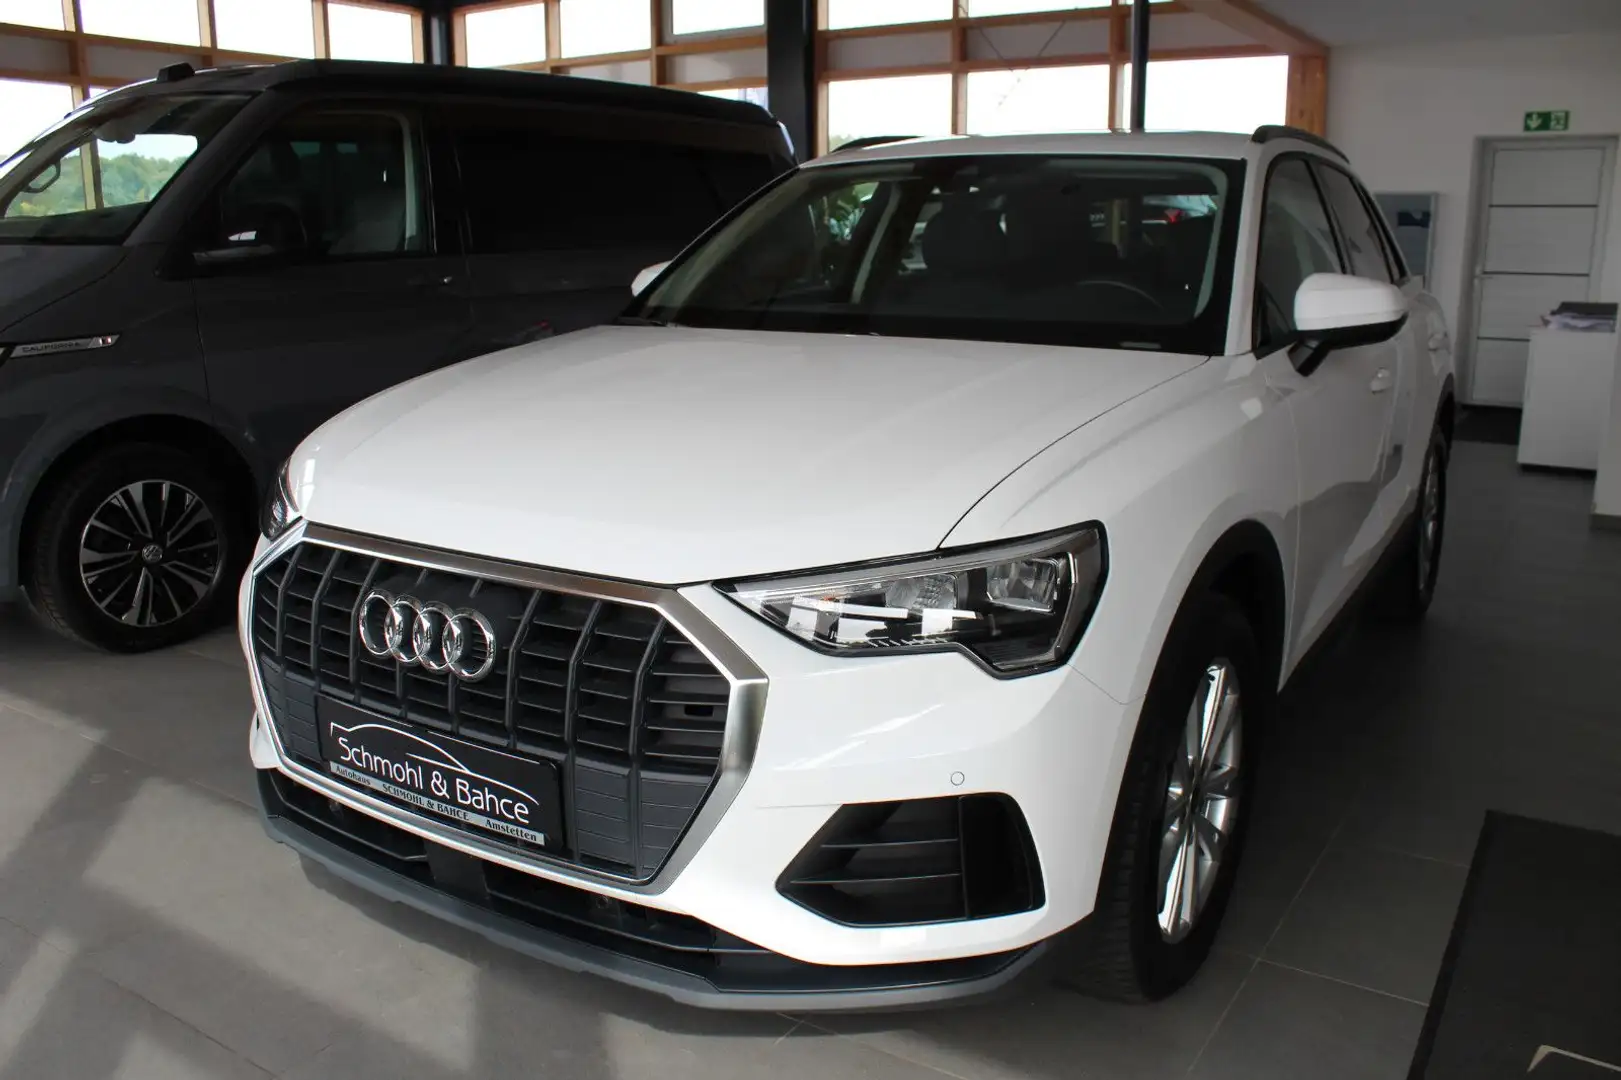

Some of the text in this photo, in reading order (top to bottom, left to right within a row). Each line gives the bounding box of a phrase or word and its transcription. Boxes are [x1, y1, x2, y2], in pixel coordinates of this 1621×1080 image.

[335, 765, 537, 842] Autohaus SCHMOHL & BAHCE Amstetten
[338, 736, 530, 825] Schmohl & Bahce
